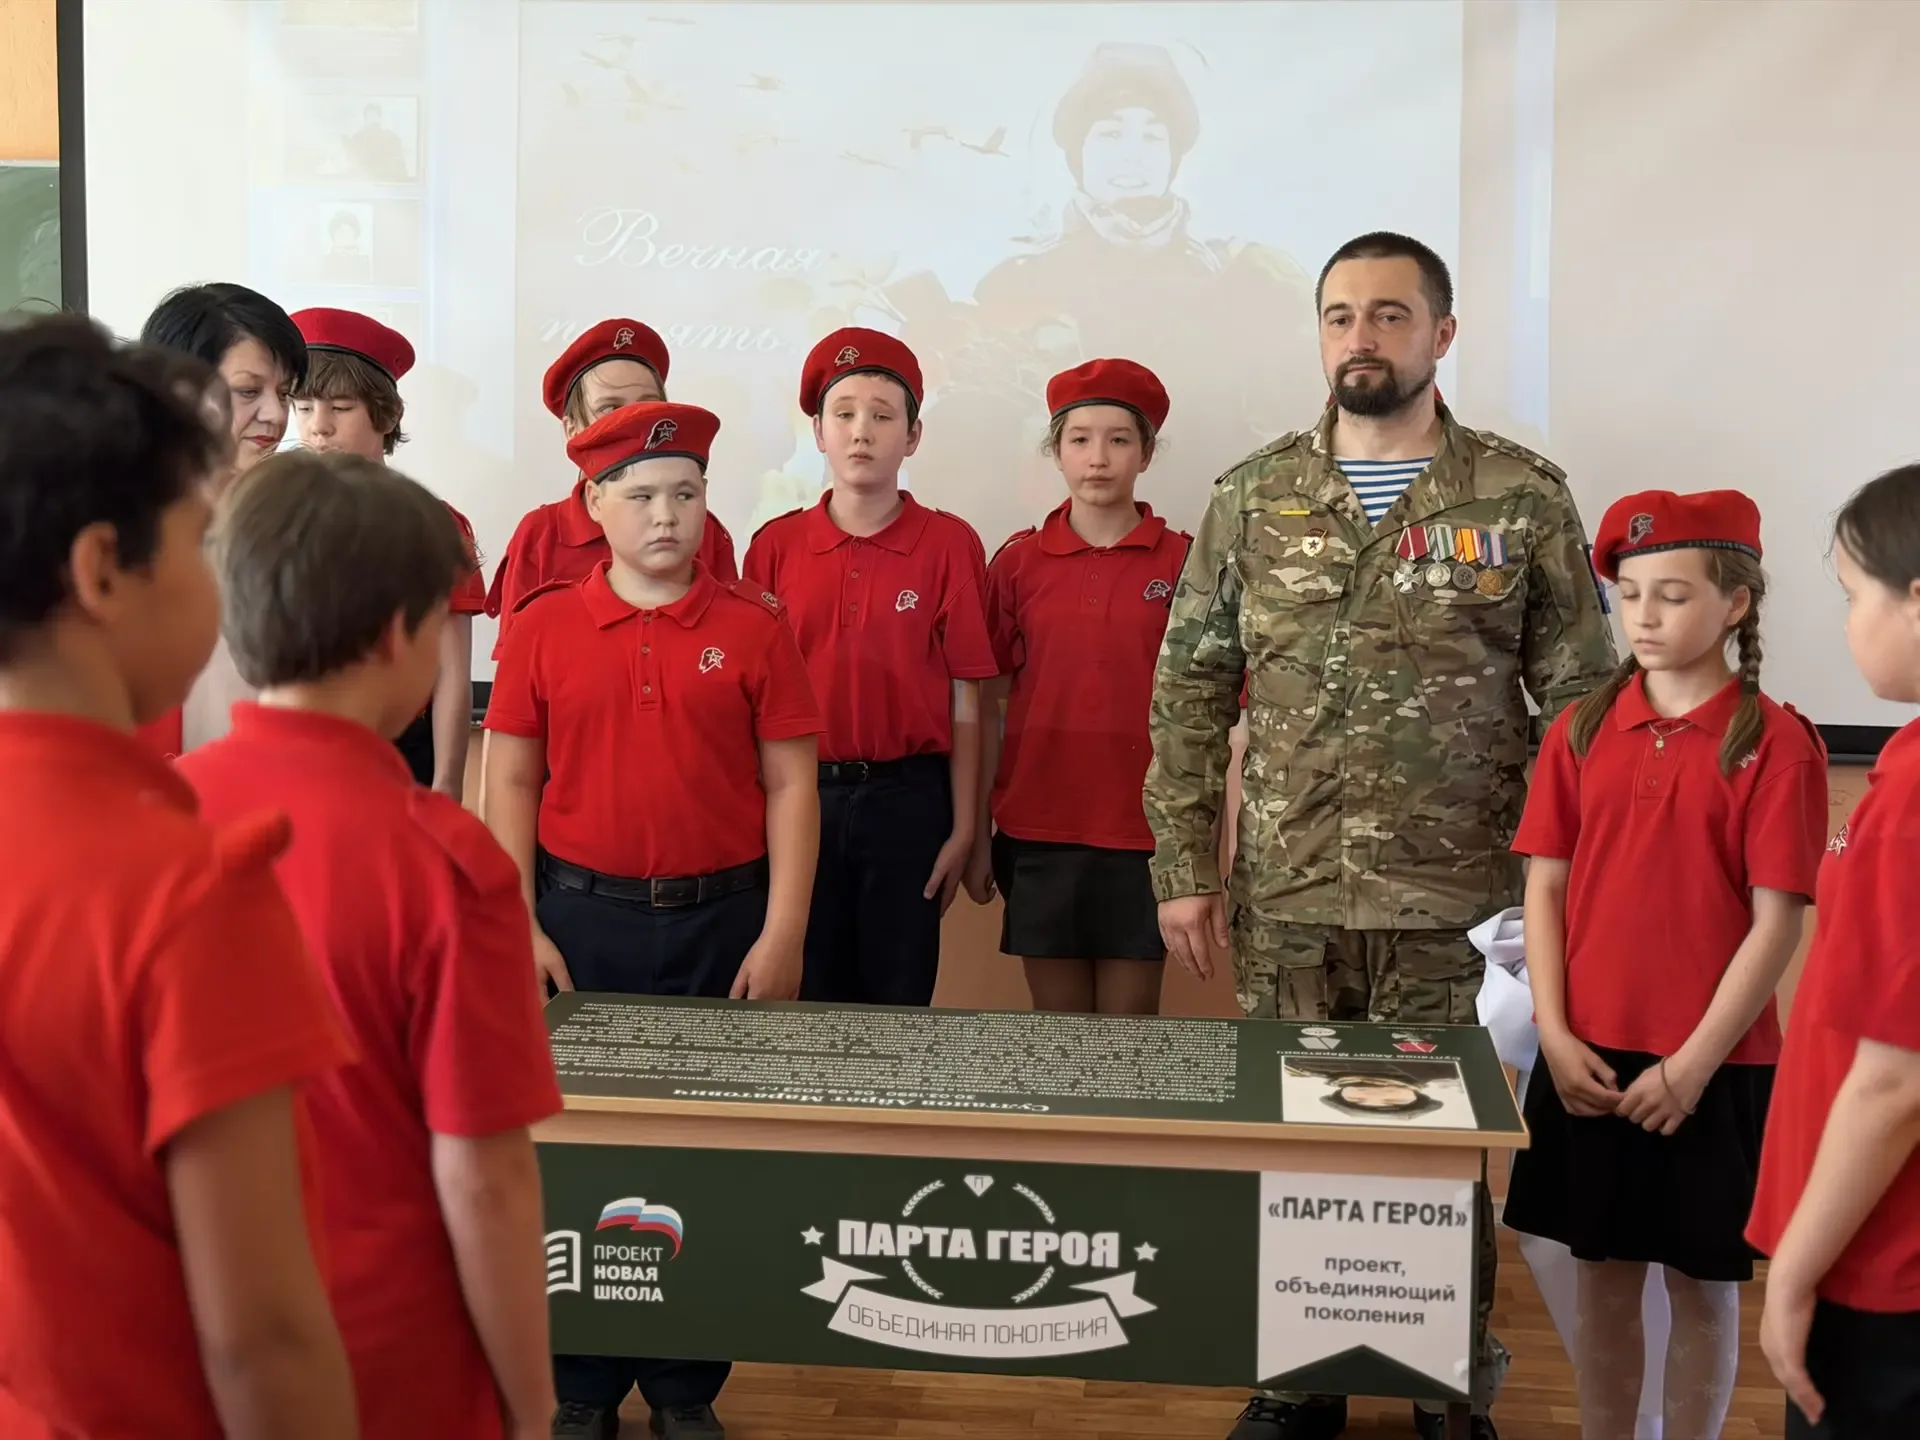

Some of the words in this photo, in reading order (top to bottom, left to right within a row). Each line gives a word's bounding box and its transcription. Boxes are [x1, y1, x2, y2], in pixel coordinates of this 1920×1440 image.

[575, 206, 824, 272] Вечная
[673, 1089, 824, 1102] Маратович
[921, 1100, 1050, 1112] Султанов
[1268, 1196, 1364, 1222] «ПАРТА
[1373, 1200, 1468, 1227] ГЕРОЯ»
[594, 1244, 664, 1262] ПРОЕКТ
[838, 1219, 977, 1259] ПАРТА
[987, 1229, 1120, 1268] ГЕРОЯ
[594, 1264, 658, 1281] НОВАЯ
[1324, 1257, 1406, 1277] проект,
[594, 1284, 664, 1302] ШКОЛА
[1275, 1276, 1456, 1302] объединяющий
[848, 1303, 976, 1343] ОБЪЕДИНЯЯ
[984, 1316, 1108, 1344] ПОКОЛЕНИЯ
[1304, 1305, 1425, 1325] поколения
